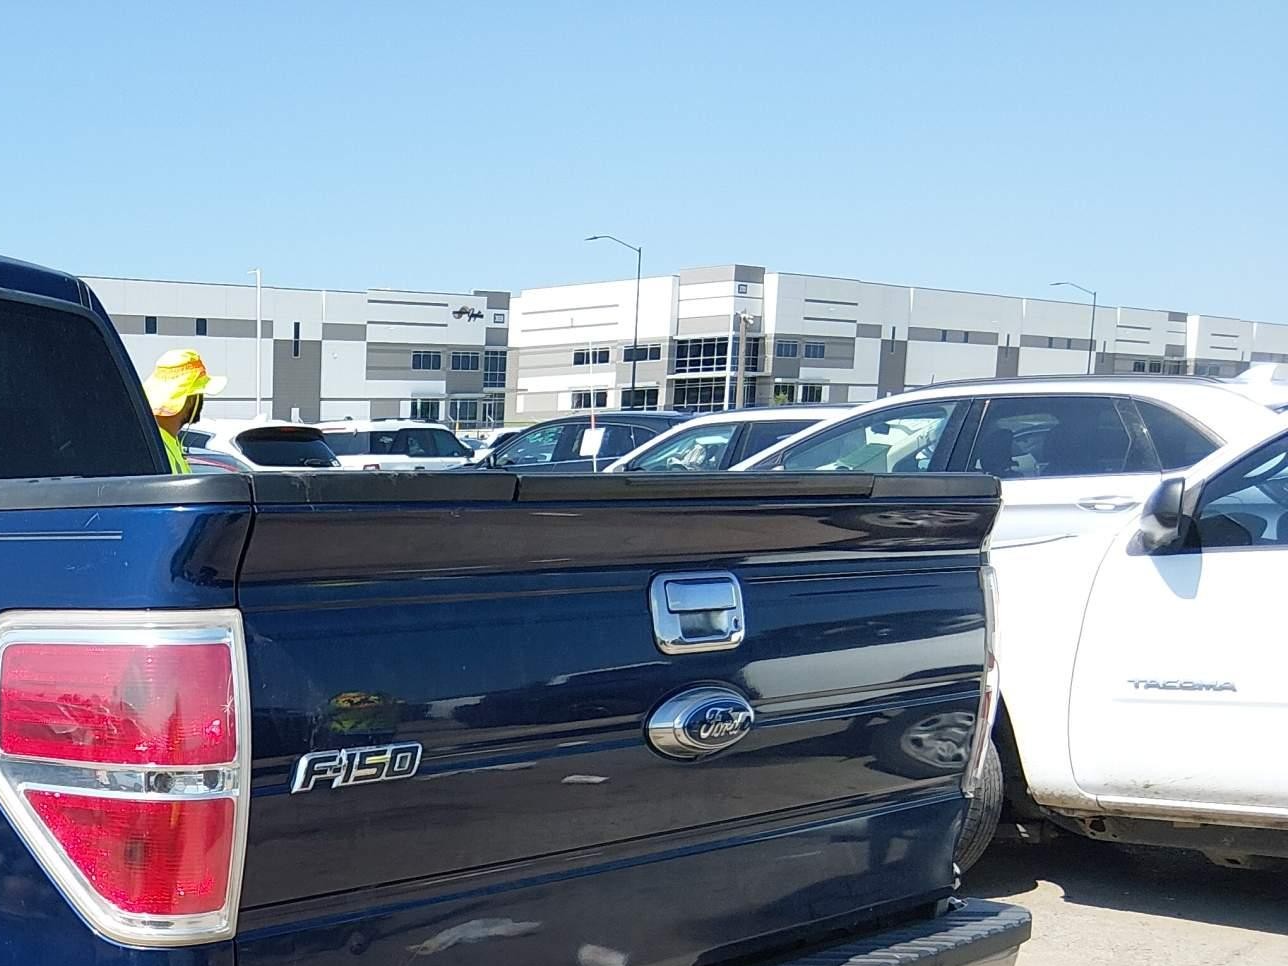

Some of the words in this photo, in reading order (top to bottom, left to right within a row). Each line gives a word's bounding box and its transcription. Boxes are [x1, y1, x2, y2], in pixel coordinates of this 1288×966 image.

[1127, 679, 1237, 692] TACOMA
[699, 706, 751, 739] Ford
[290, 742, 422, 793] F-150
